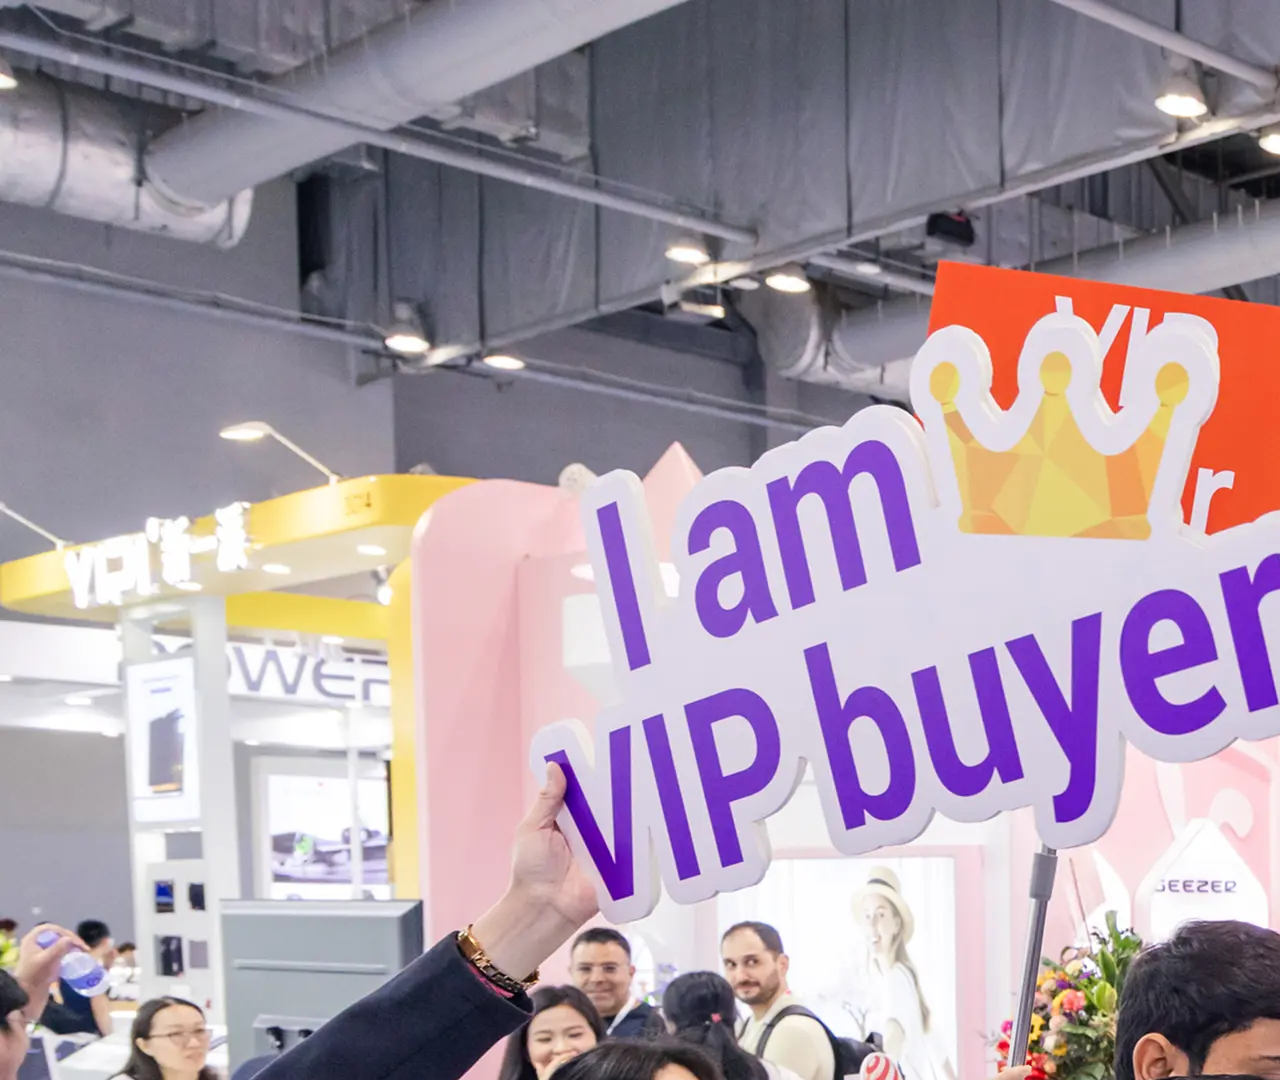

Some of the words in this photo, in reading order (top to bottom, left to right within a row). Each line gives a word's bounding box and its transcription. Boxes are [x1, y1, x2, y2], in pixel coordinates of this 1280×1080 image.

[596, 501, 652, 671] I
[687, 439, 921, 639] am
[544, 686, 780, 903] VIP
